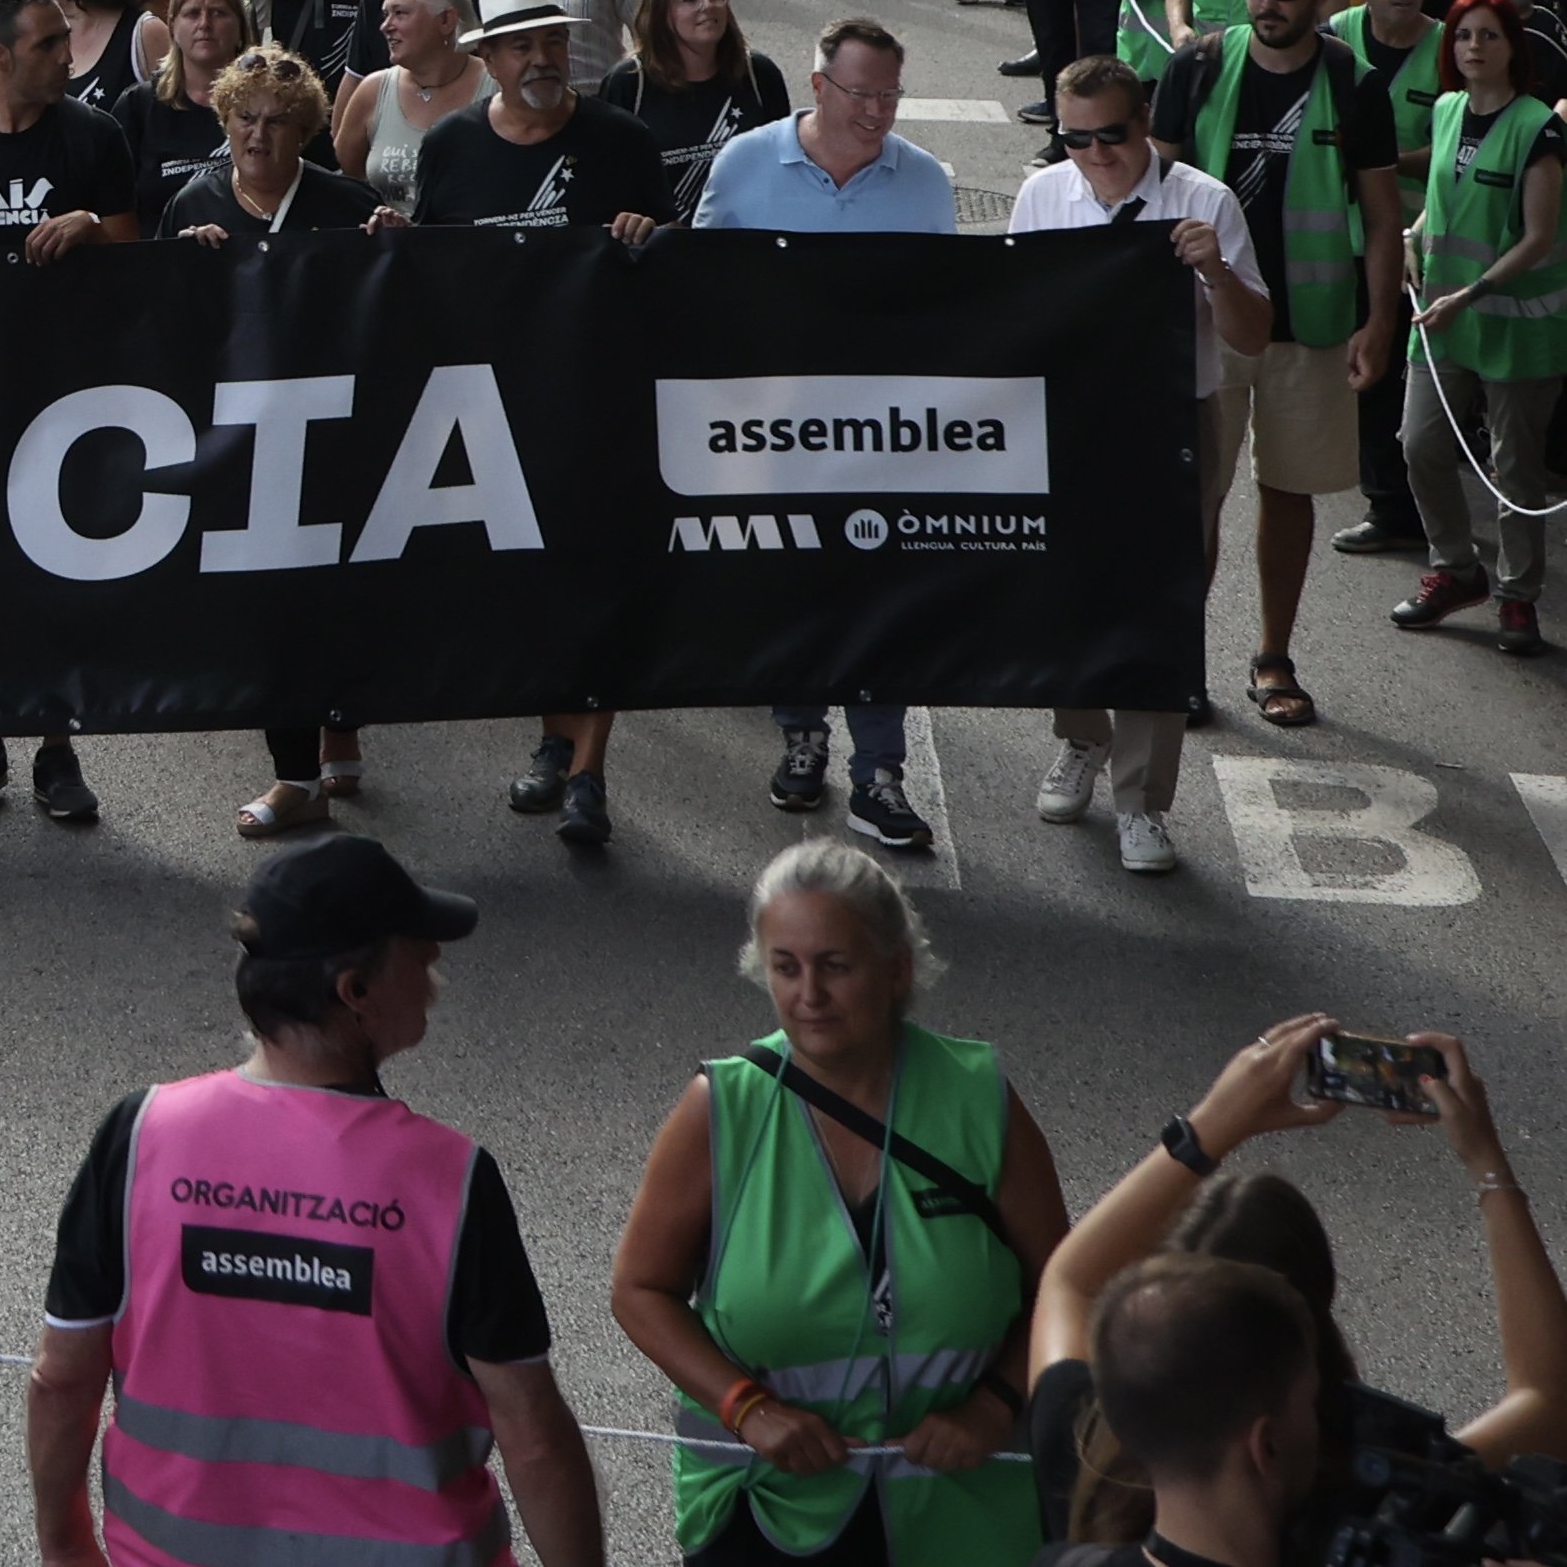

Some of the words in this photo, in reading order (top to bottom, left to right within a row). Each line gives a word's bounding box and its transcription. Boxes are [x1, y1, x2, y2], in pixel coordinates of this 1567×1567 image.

[707, 406, 1006, 453] assemblea
[897, 509, 1047, 537] ÒMNIUM
[900, 541, 956, 551] LLENGUA
[960, 541, 1018, 551] CULTURA
[1021, 540, 1047, 552] PAÍS
[1213, 754, 1482, 907] B
[170, 1177, 406, 1232] ORGANITZACIÓ
[201, 1246, 352, 1291] assemblea
